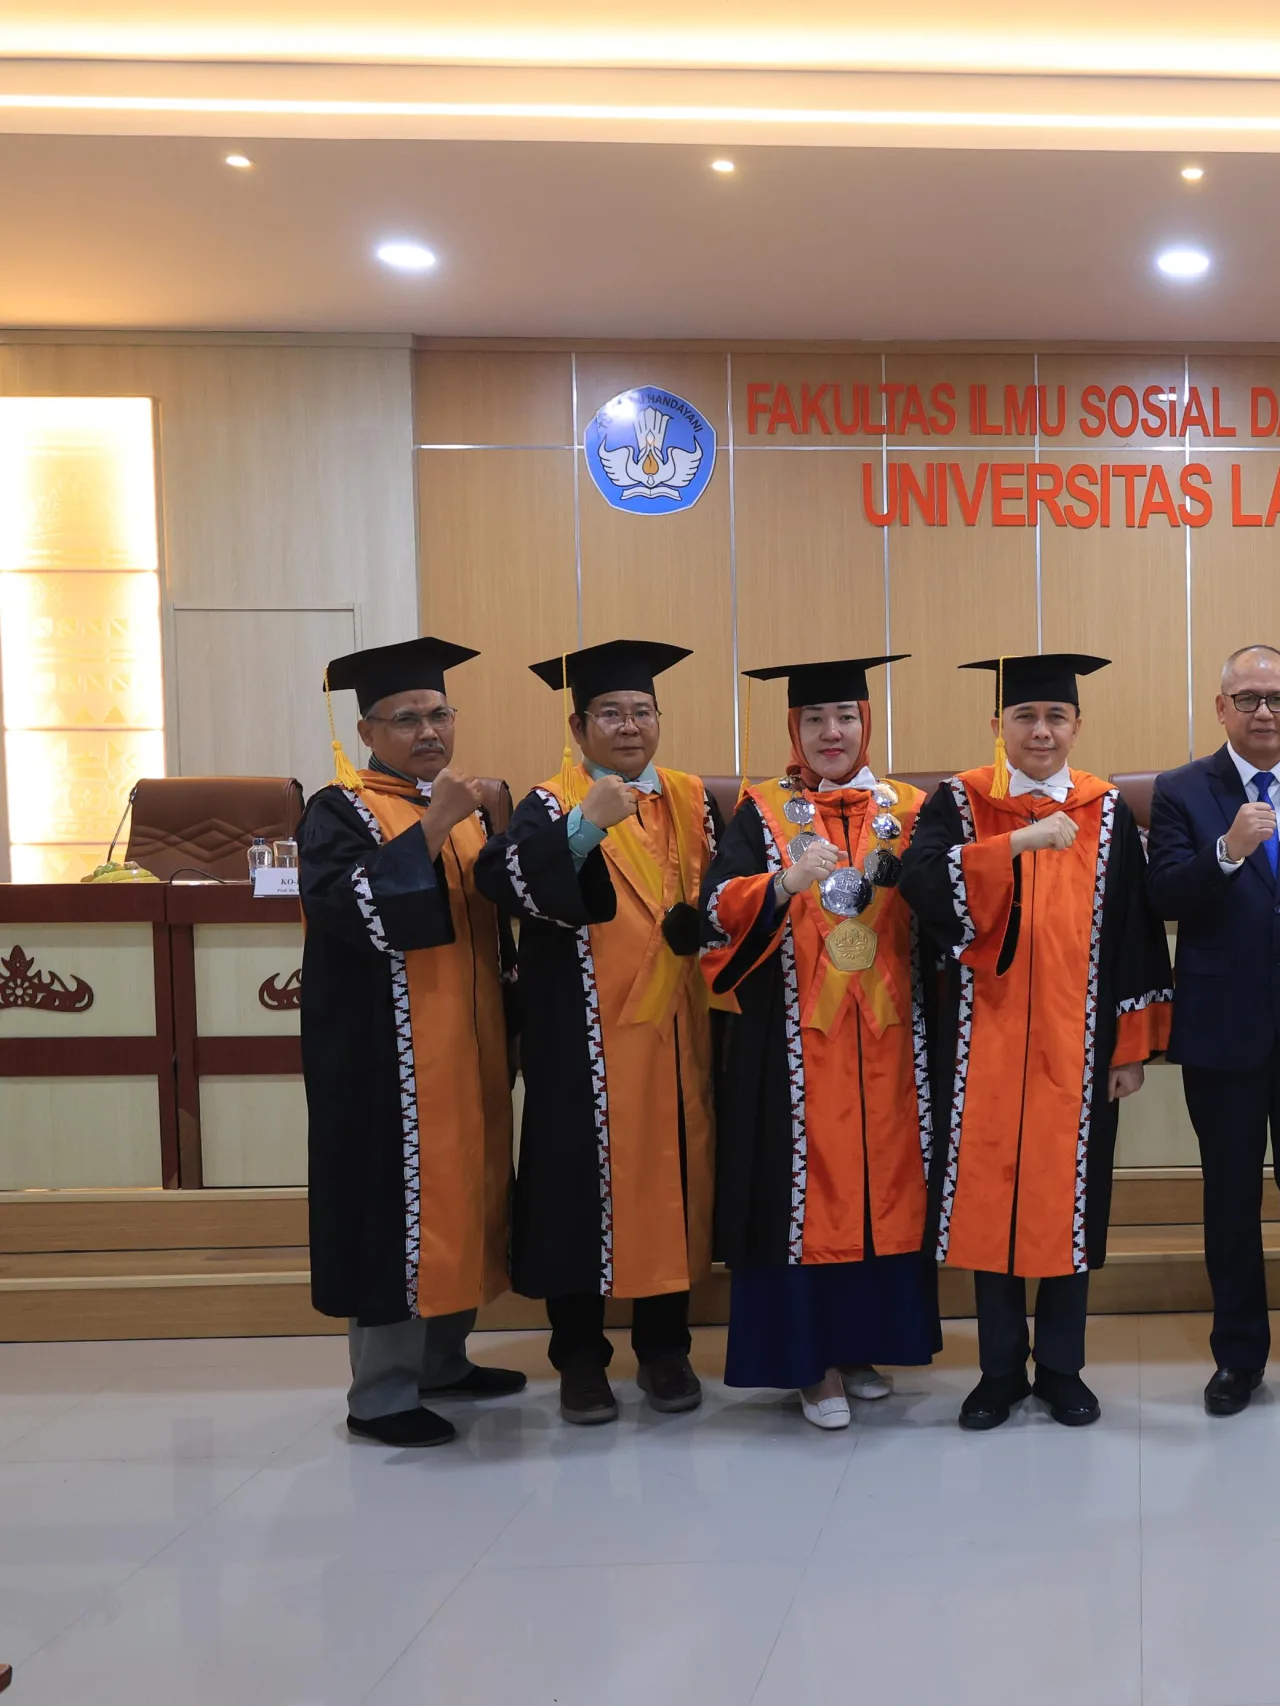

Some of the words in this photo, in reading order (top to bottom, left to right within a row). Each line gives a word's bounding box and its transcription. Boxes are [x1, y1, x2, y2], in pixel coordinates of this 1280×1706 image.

[647, 392, 704, 433] HANDAYANI
[746, 380, 957, 436] FAKULTAS
[968, 383, 1066, 437] ILMU
[1079, 384, 1237, 438] SOSIAL
[862, 462, 1213, 528] UNIVERSITAS
